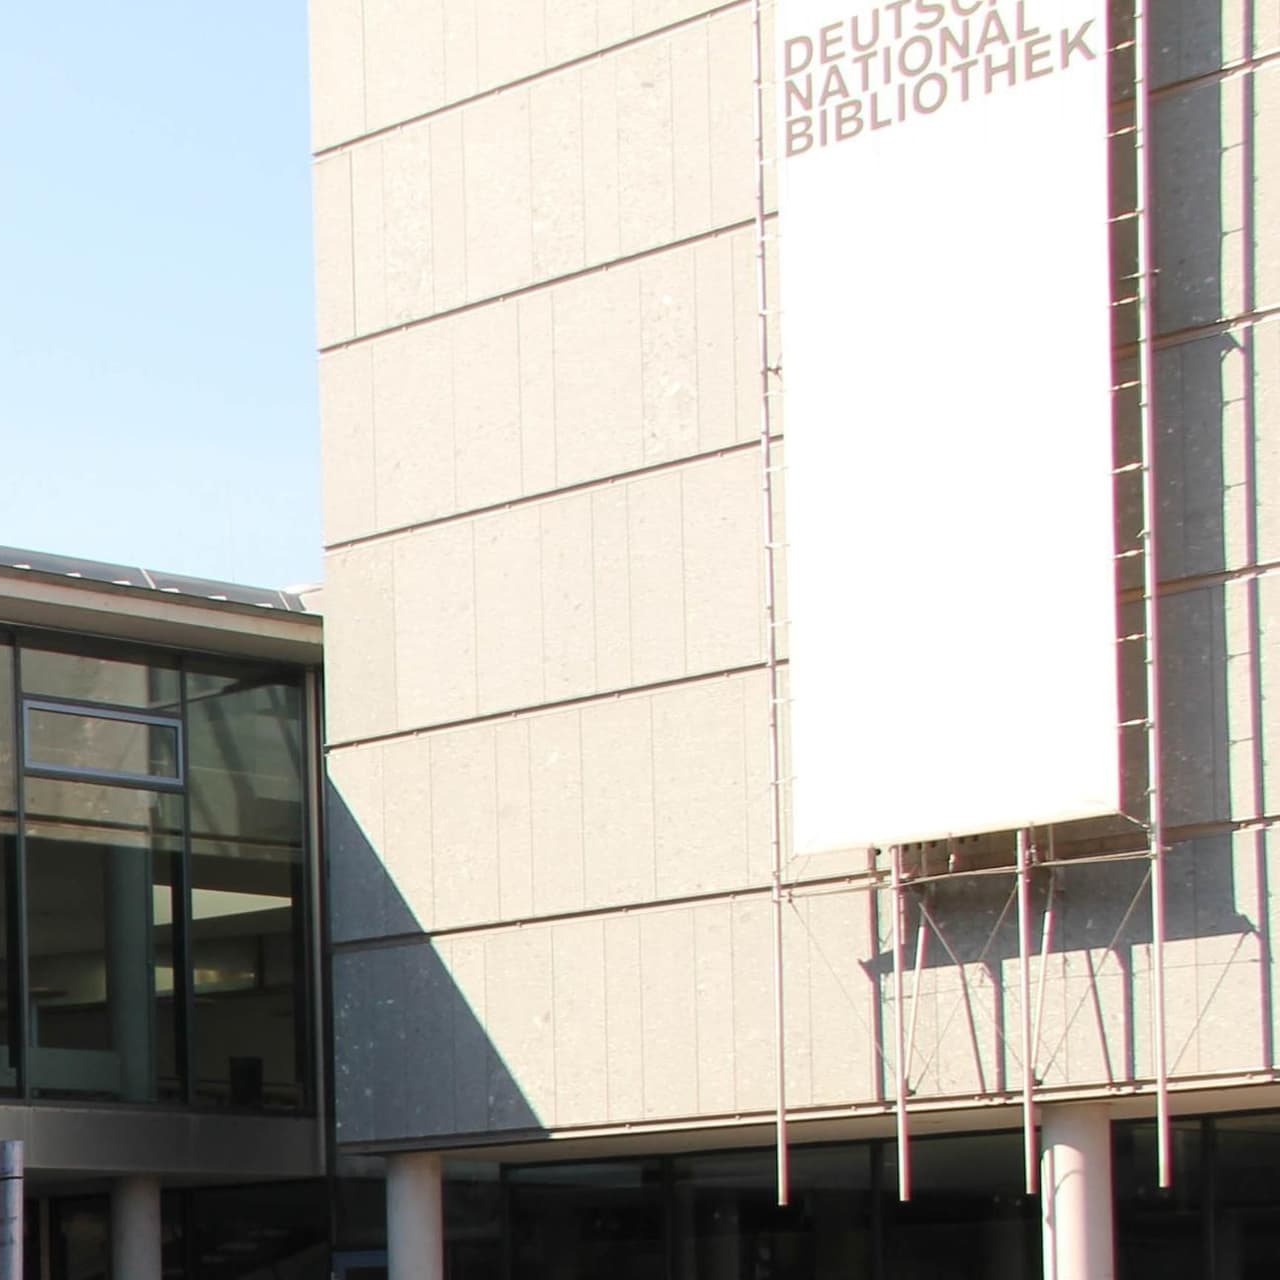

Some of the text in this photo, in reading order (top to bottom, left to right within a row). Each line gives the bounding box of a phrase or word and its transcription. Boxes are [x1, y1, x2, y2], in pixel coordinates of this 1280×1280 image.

[784, 0, 996, 77] DEUTS
[784, 0, 1040, 117] NATIONAL
[785, 18, 1097, 158] BIBLIOTHEK
